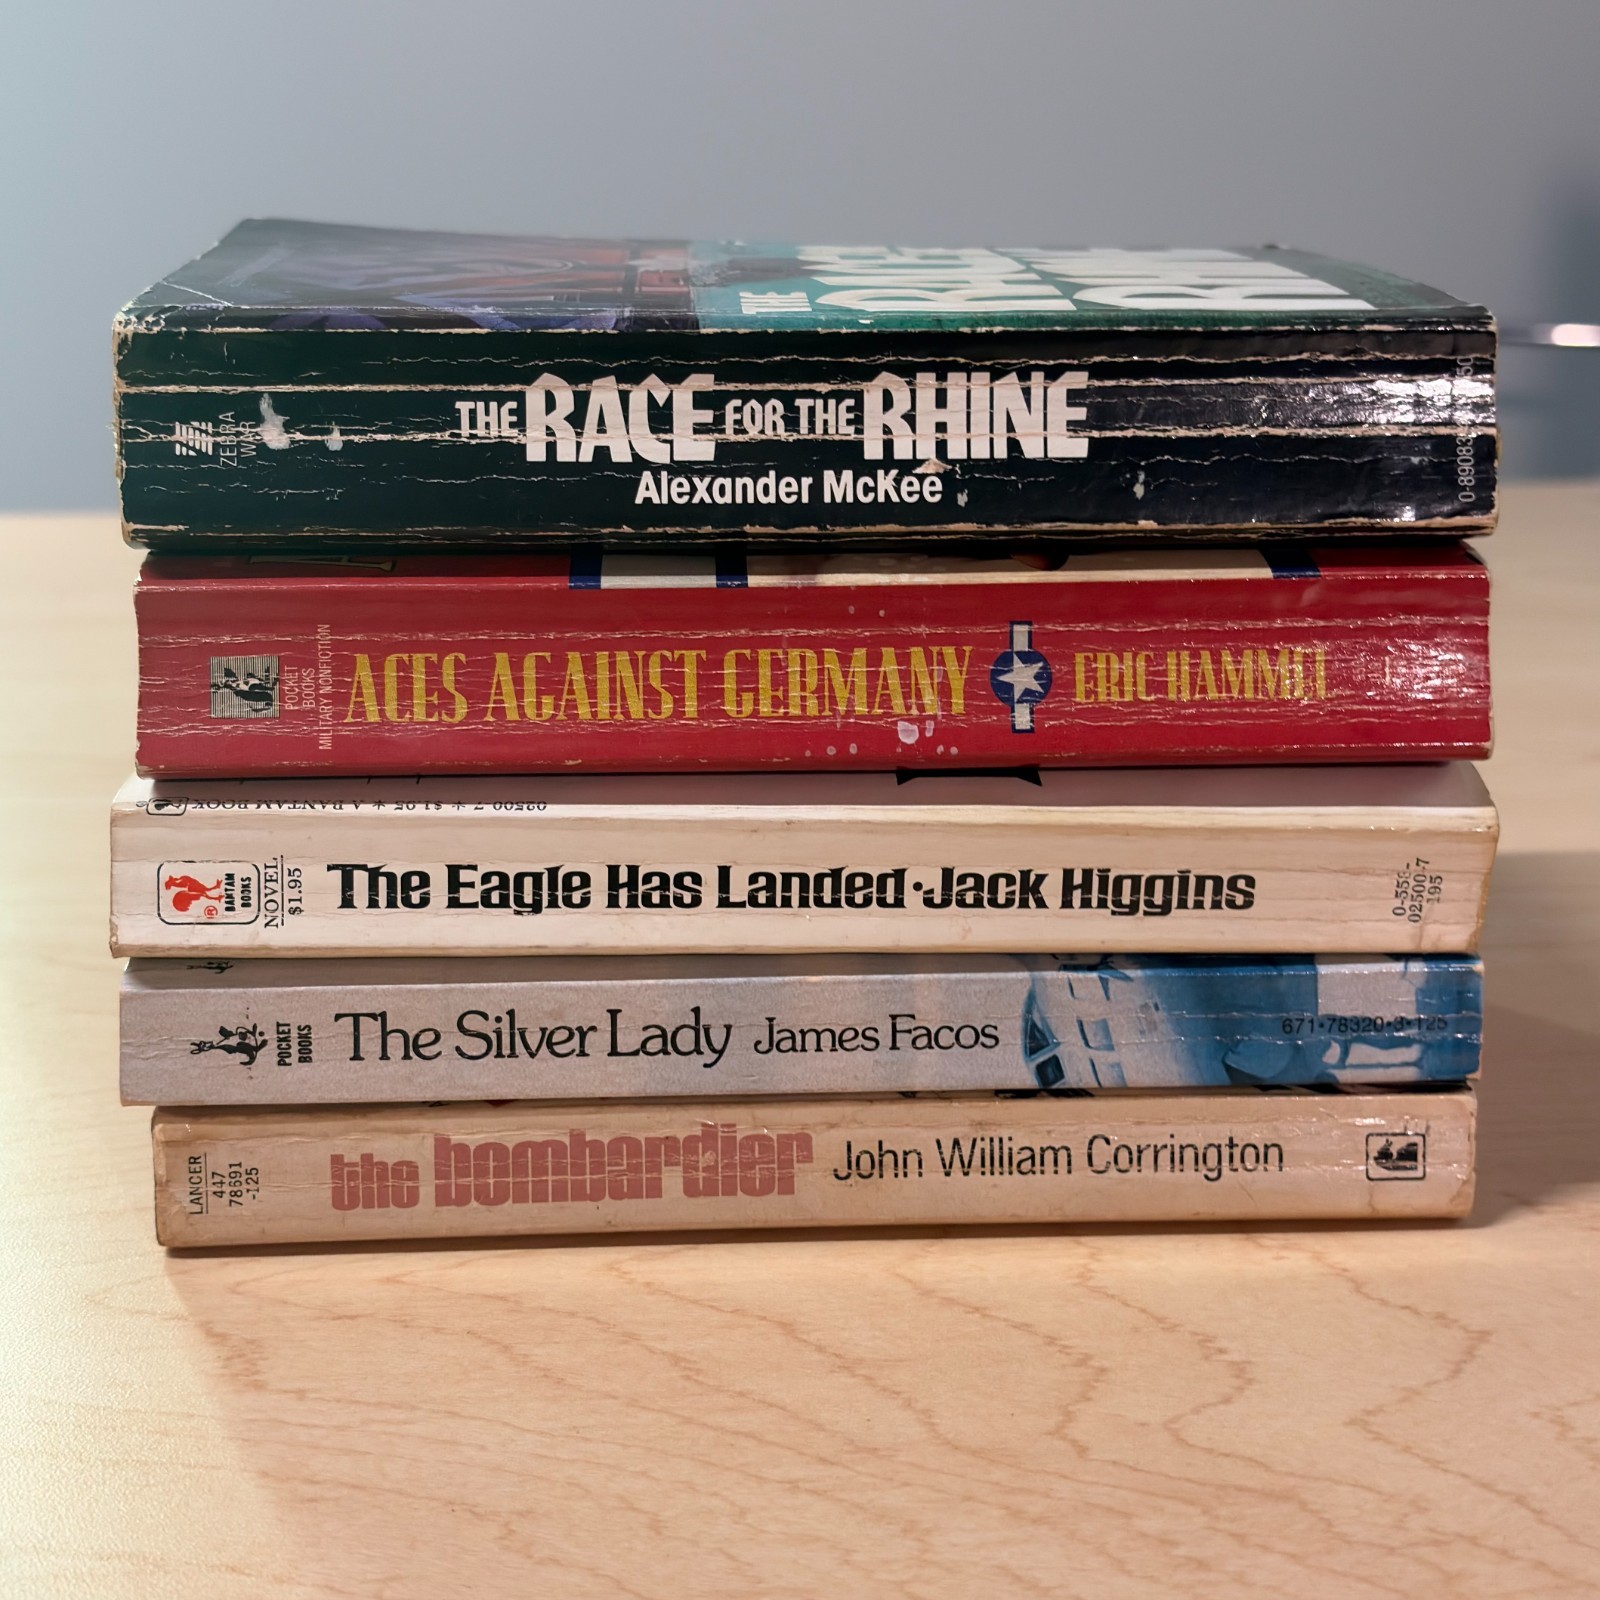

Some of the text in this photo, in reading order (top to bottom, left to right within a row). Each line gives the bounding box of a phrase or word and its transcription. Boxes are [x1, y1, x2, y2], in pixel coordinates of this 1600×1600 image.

[220, 411, 238, 467] ZEBRA
[240, 420, 256, 458] WAR
[455, 371, 1089, 463] THE RACE FOR THE RHINE
[635, 469, 943, 504] Alexander McKee
[285, 665, 298, 710] POCKET
[301, 667, 316, 708] BOOKS
[317, 624, 333, 750] MILITARY NONFICTION
[344, 646, 973, 723] ACES AGAINST GERMANY
[1074, 651, 1154, 702] ERIC
[192, 800, 248, 810] BOOK
[255, 800, 344, 810] BANTAM
[225, 873, 236, 912] BANTAM
[240, 876, 252, 908] BOOKS
[264, 857, 279, 928] NOVEL
[288, 867, 304, 915] $1.95
[327, 864, 431, 909] The
[445, 864, 591, 916] Eagle
[606, 864, 702, 909] Has
[1059, 867, 1256, 917] Higgins
[1426, 875, 1443, 904] 195
[276, 1021, 292, 1066] POCKET
[297, 1024, 313, 1063] BOOKS
[334, 1006, 733, 1068] The Silver Lady
[753, 1014, 1000, 1055] James Facos
[330, 1122, 814, 1211] the bombardier
[833, 1133, 1284, 1182] John William Corrington
[188, 1155, 203, 1215] LANCER
[212, 1171, 226, 1198] 447
